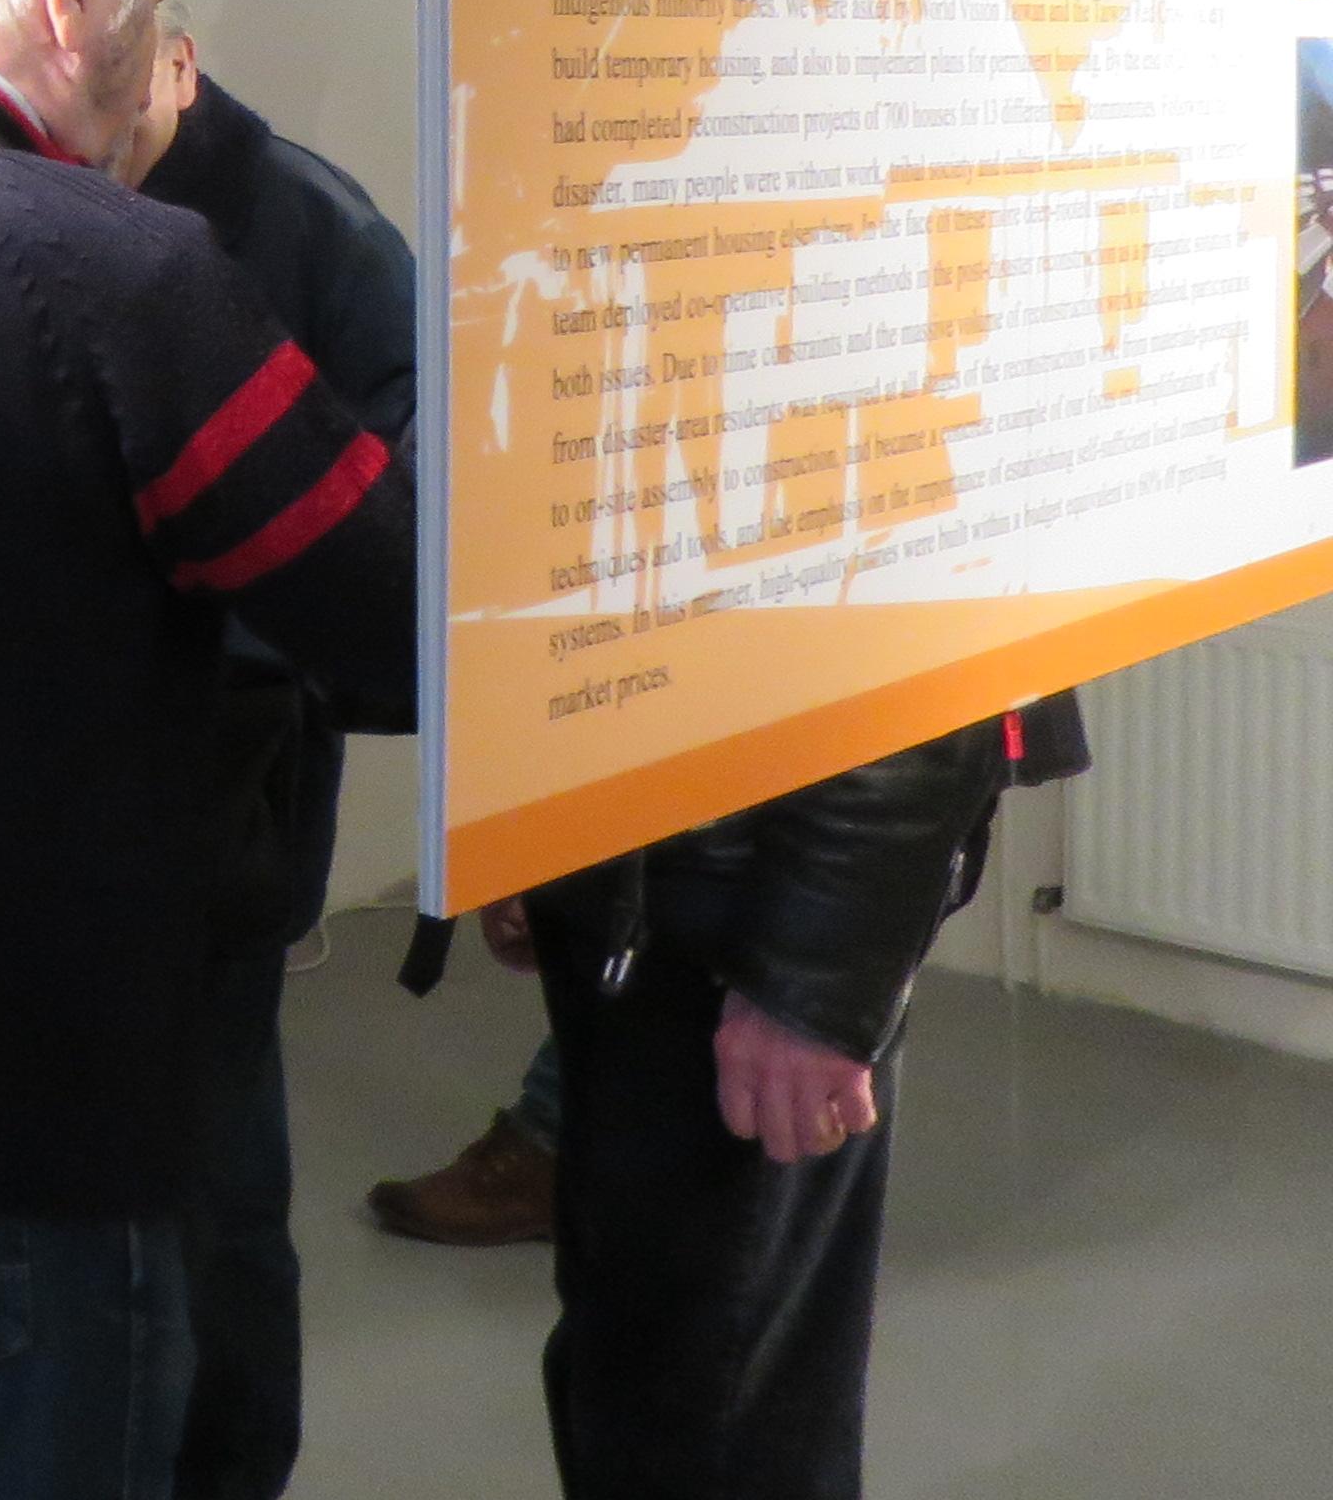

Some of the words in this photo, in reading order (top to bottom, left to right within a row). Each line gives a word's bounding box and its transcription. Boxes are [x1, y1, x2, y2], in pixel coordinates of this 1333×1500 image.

[552, 48, 598, 79] build
[606, 53, 693, 85] temporary
[771, 47, 797, 76] and
[803, 47, 832, 75] also
[835, 51, 849, 75] to
[552, 112, 584, 143] had
[591, 109, 680, 148] completed
[633, 179, 679, 207] many
[685, 166, 738, 206] people
[743, 172, 780, 194] were
[553, 246, 570, 271] to
[577, 245, 610, 269] new
[619, 232, 707, 272] permanent
[714, 225, 774, 258] housing
[552, 310, 596, 336] team
[603, 291, 680, 334] deployed
[552, 365, 592, 400] both
[663, 353, 695, 383] Due
[701, 352, 717, 377] to
[552, 432, 595, 463] from
[551, 503, 569, 528] to
[575, 487, 635, 523] on-site
[641, 467, 716, 509] assembly
[724, 467, 738, 491] to
[550, 550, 645, 592] techniques
[652, 533, 681, 567] and
[656, 595, 685, 627] this
[549, 678, 611, 717] market
